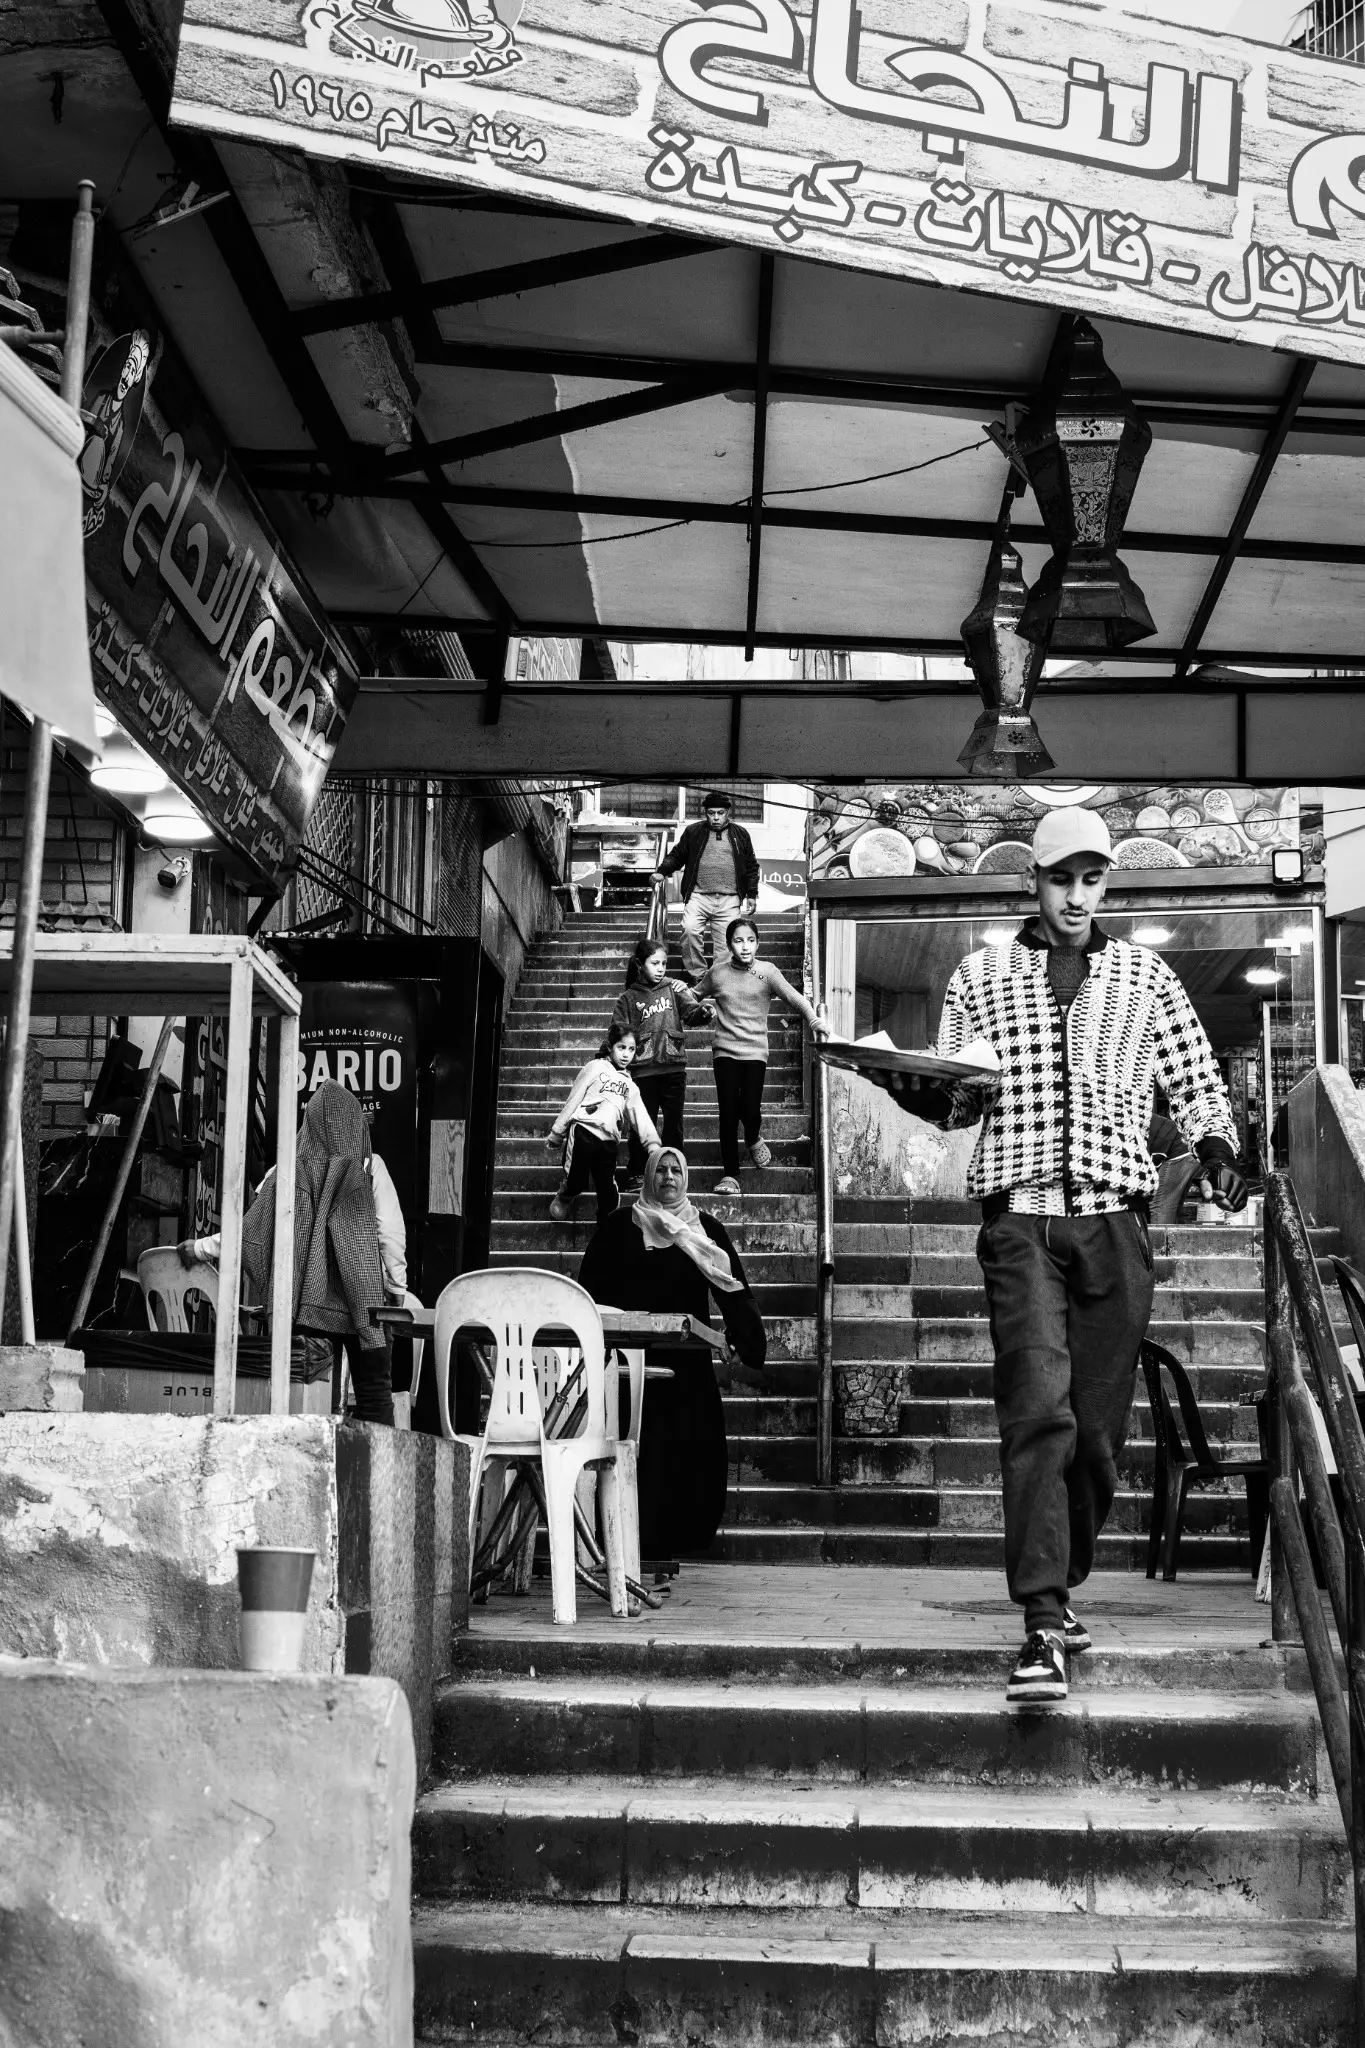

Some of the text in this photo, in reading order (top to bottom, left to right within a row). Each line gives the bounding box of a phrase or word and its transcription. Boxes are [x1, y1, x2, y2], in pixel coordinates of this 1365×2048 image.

[419, 49, 523, 88] مطعم
[657, 0, 1243, 197] النجاح
[268, 69, 547, 164] منذ عام ١٩٦٥
[644, 124, 864, 242] كبدة
[914, 177, 1153, 286] قلايات
[1206, 241, 1365, 330] لافل
[122, 431, 327, 780] مطعم النجاح
[184, 730, 229, 795] فلافل
[223, 775, 258, 831] فول
[300, 1028, 403, 1043] MIUM NON-ALCOHOLIC
[640, 996, 673, 1022] smile
[163, 1386, 212, 1397] BLUE
